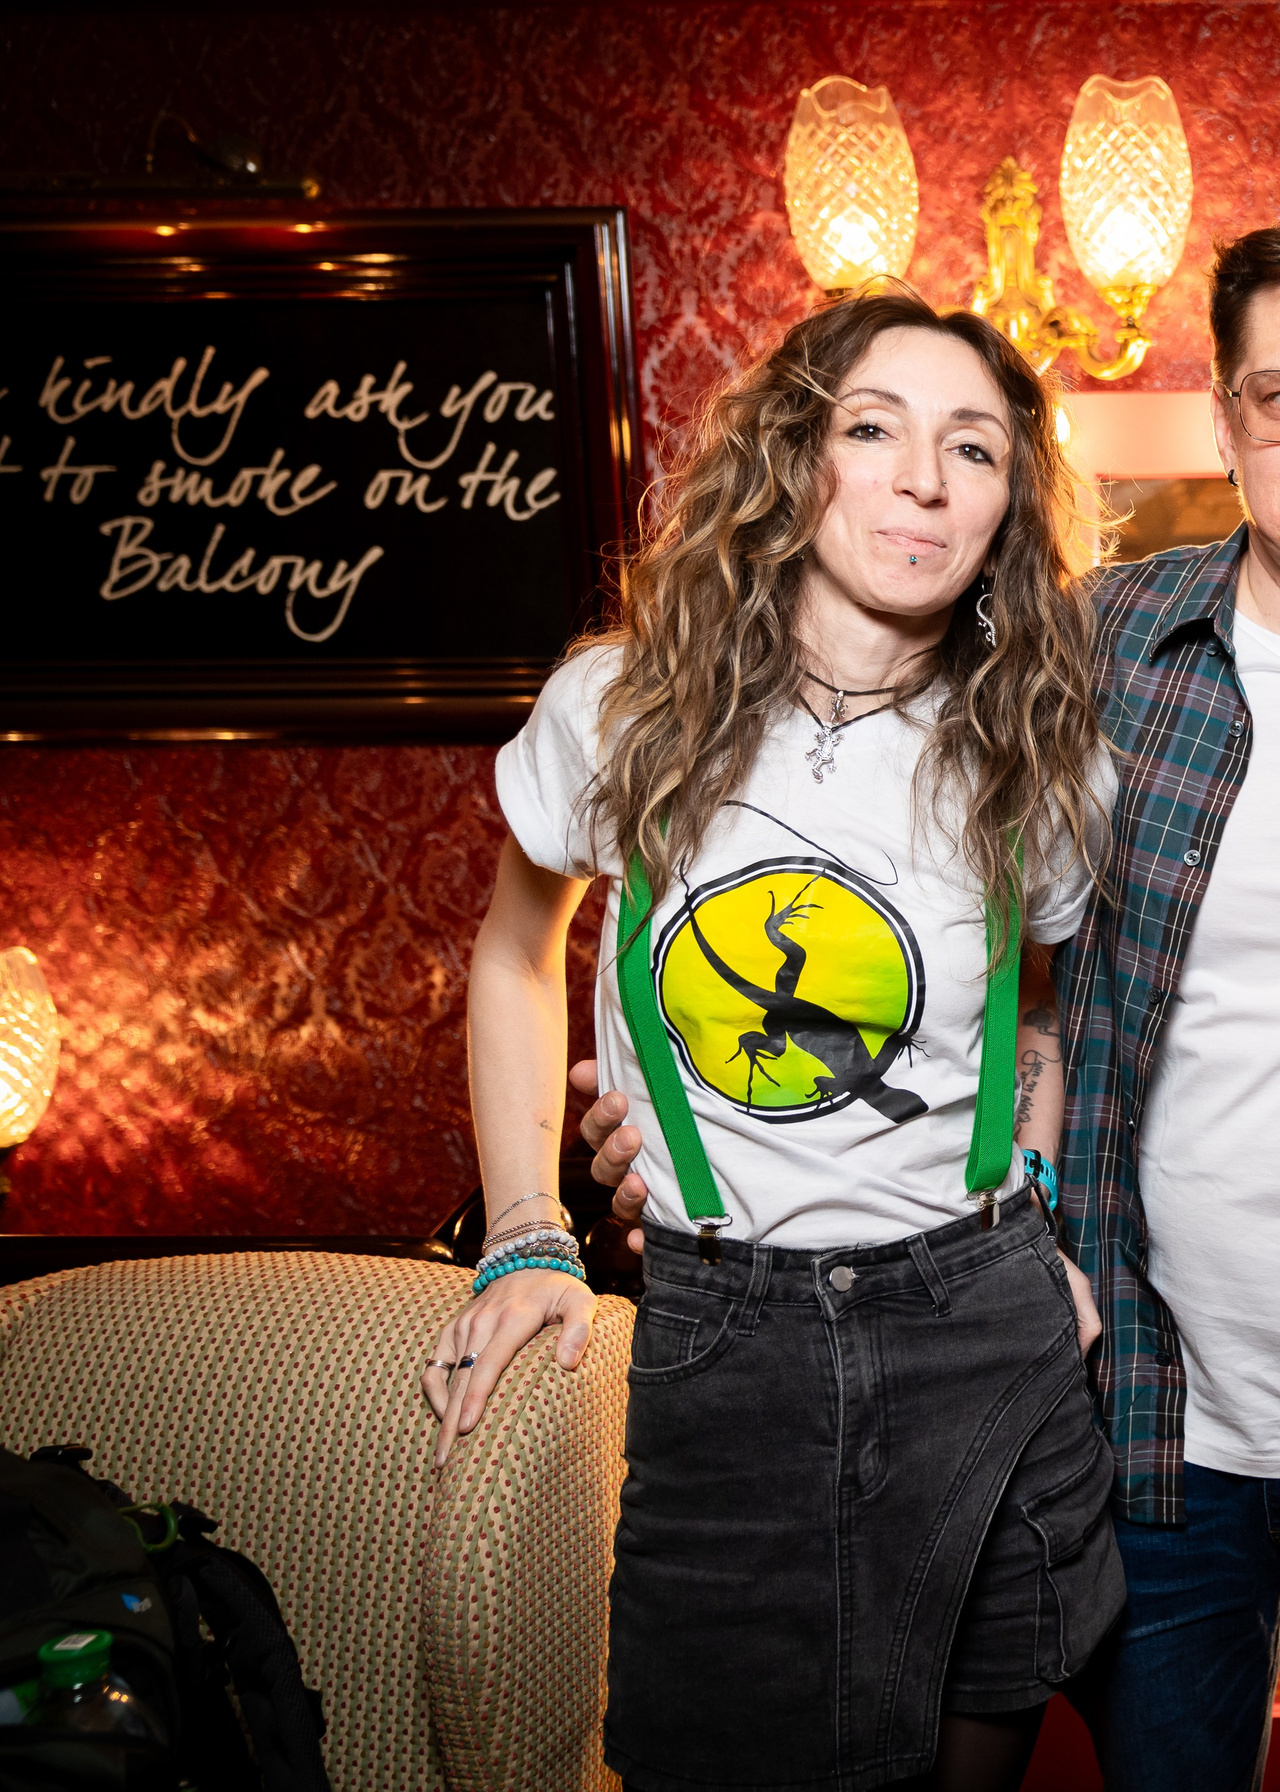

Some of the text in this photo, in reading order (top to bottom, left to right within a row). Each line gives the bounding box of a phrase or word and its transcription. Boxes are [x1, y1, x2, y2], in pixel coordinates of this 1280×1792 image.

[39, 345, 555, 470] kindly ask you
[40, 436, 116, 504] to
[137, 448, 337, 516] smoke
[364, 468, 448, 513] on
[459, 442, 560, 521] the
[100, 516, 384, 642] Balcony
